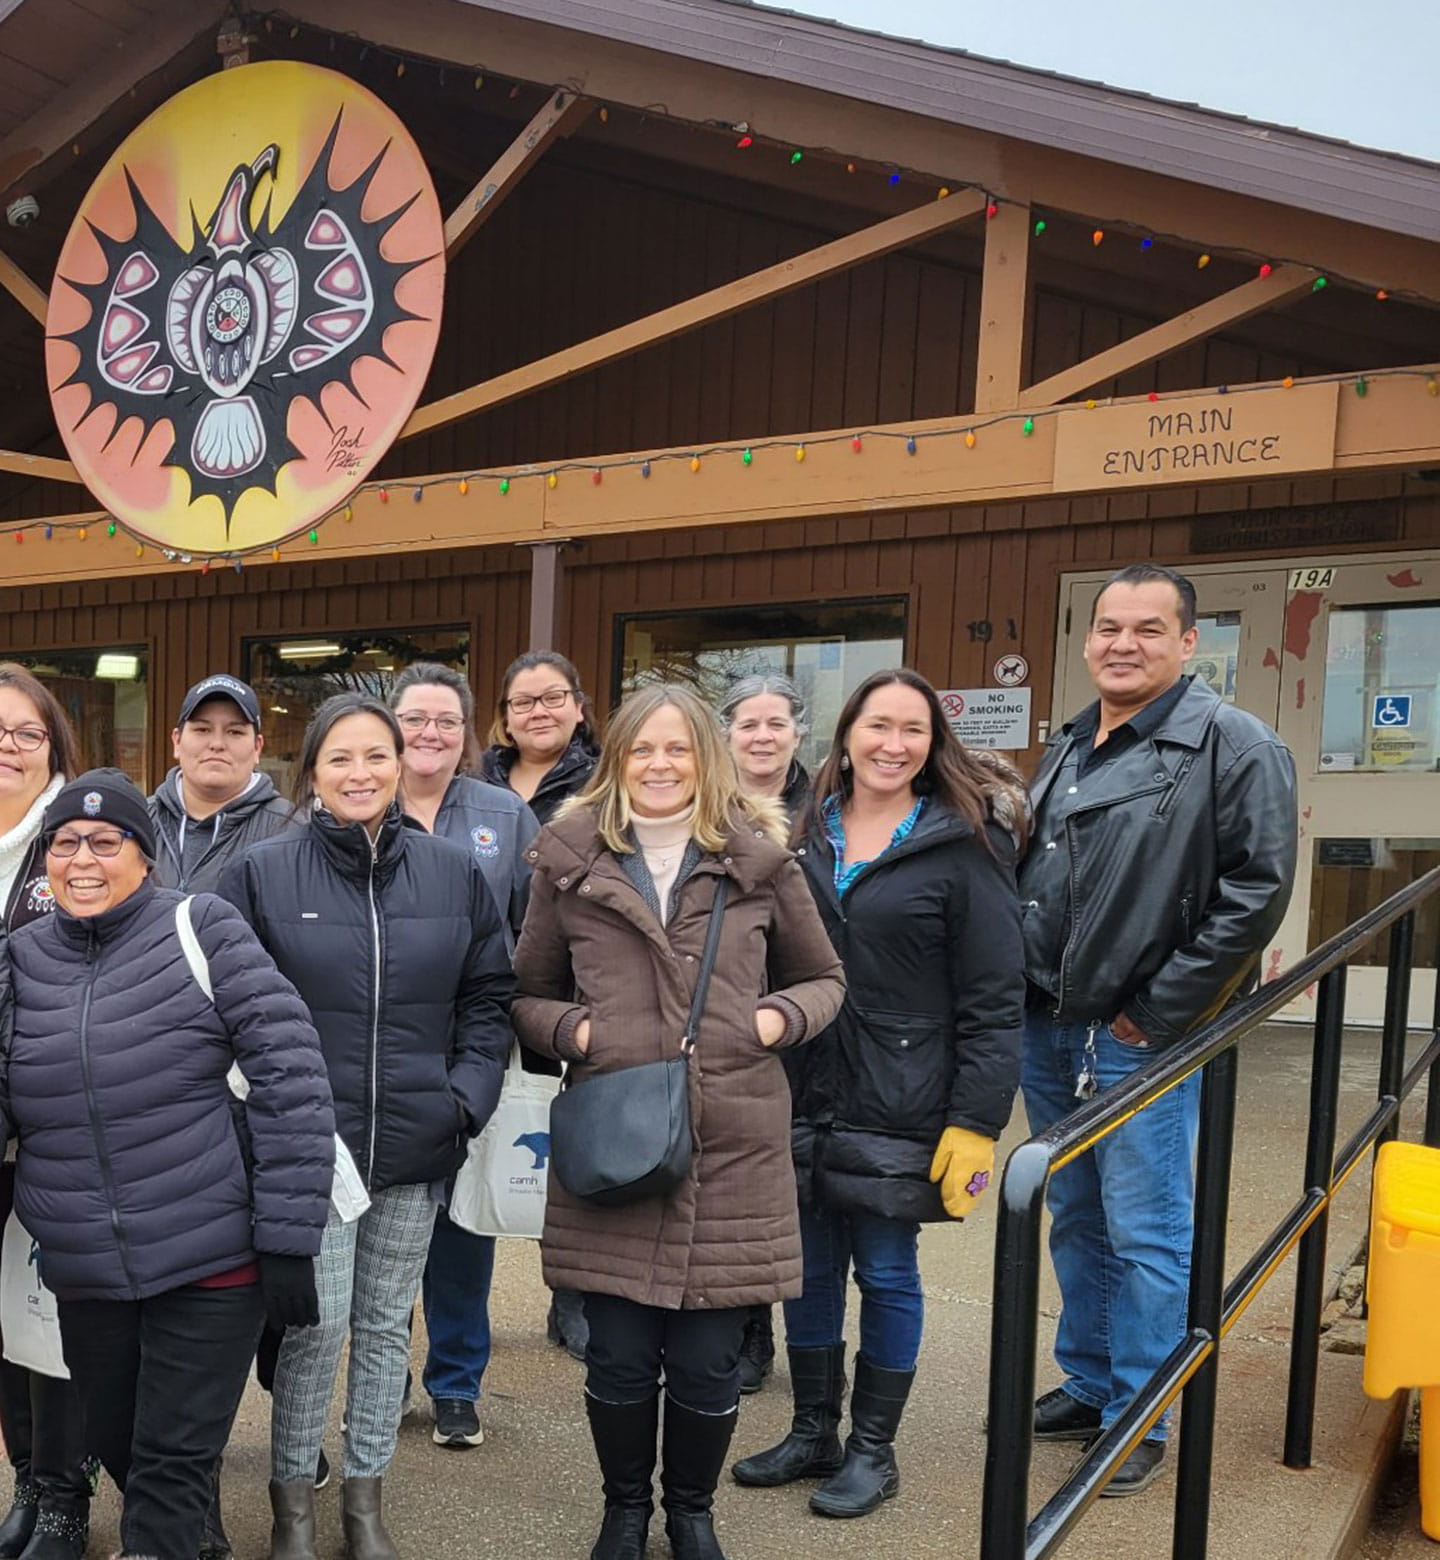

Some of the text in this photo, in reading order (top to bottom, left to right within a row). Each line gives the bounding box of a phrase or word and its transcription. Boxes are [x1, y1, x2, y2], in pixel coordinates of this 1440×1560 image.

[1148, 407, 1232, 437] MAIN
[1103, 435, 1280, 474] ENTRANCE
[1293, 569, 1333, 588] 19A
[967, 620, 992, 642] 19
[988, 694, 1005, 703] NO
[968, 704, 1024, 715] SMOKING
[510, 1176, 538, 1185] camh
